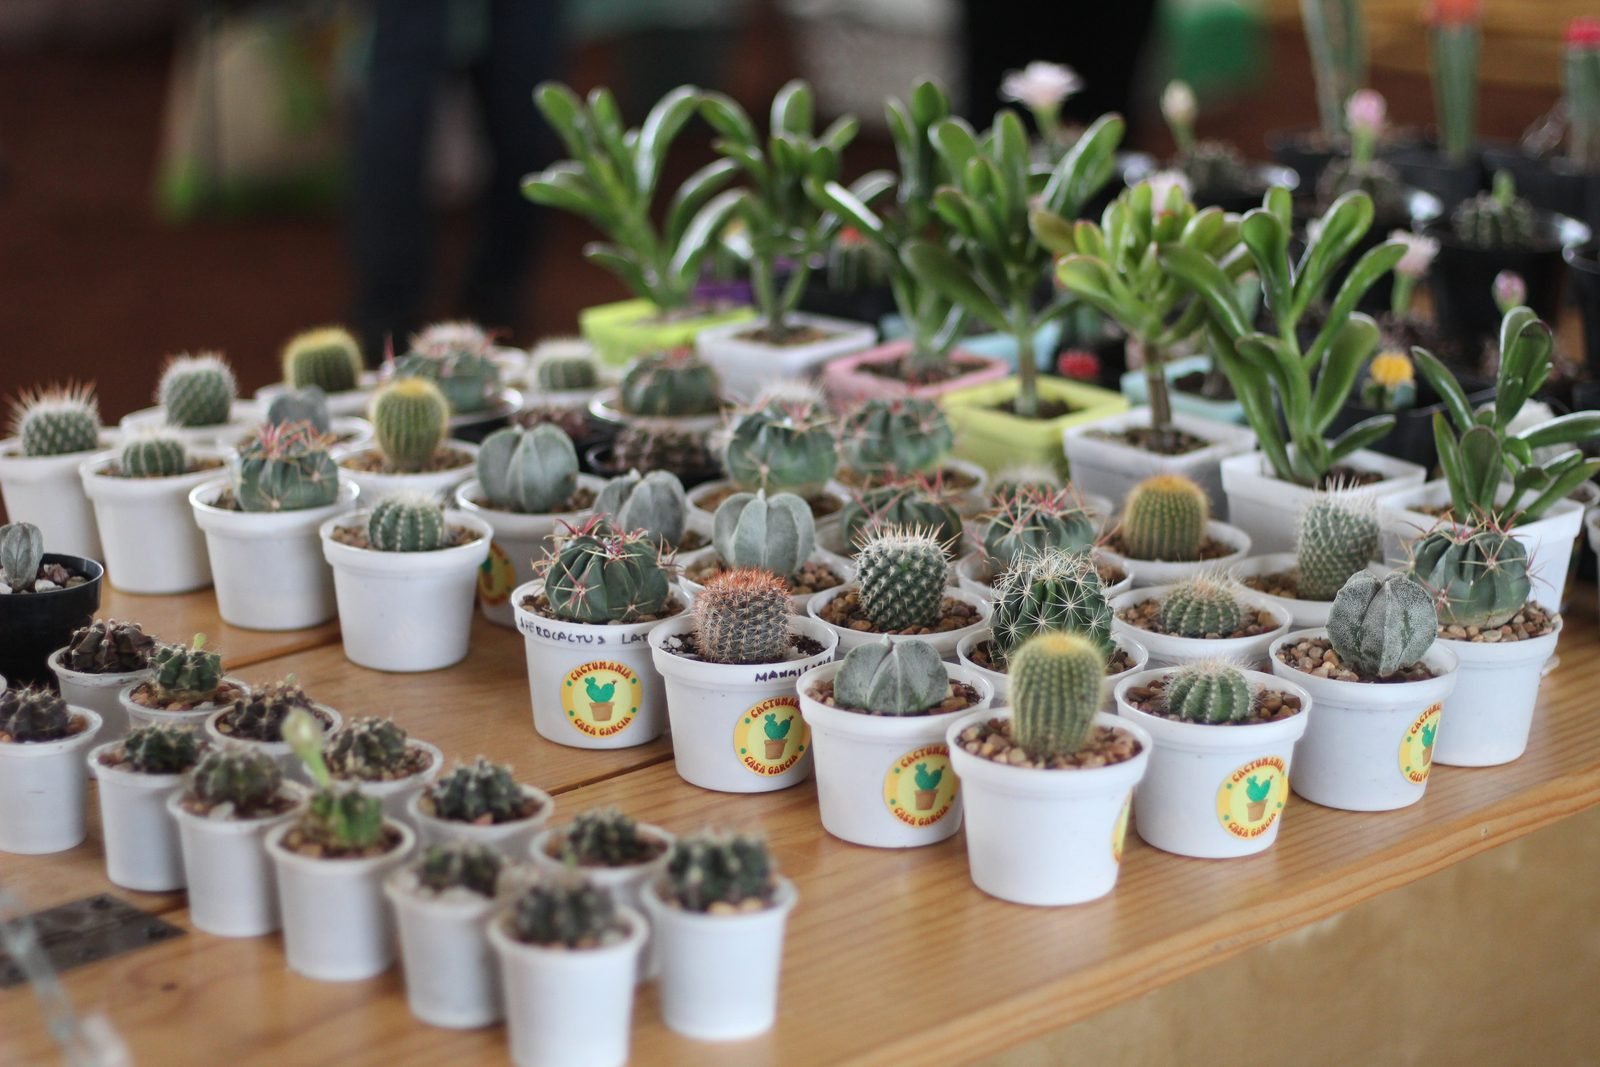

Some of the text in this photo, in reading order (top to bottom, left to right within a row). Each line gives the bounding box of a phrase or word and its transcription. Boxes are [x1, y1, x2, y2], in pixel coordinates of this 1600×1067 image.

[570, 661, 632, 681] CACTUMANIA
[750, 697, 802, 719] CACTUMAN
[574, 716, 632, 736] CASA GARCIA
[744, 753, 798, 775] CASA GARCIA
[894, 807, 916, 826] CASA
[1228, 812, 1277, 838] CASA GARCIA
